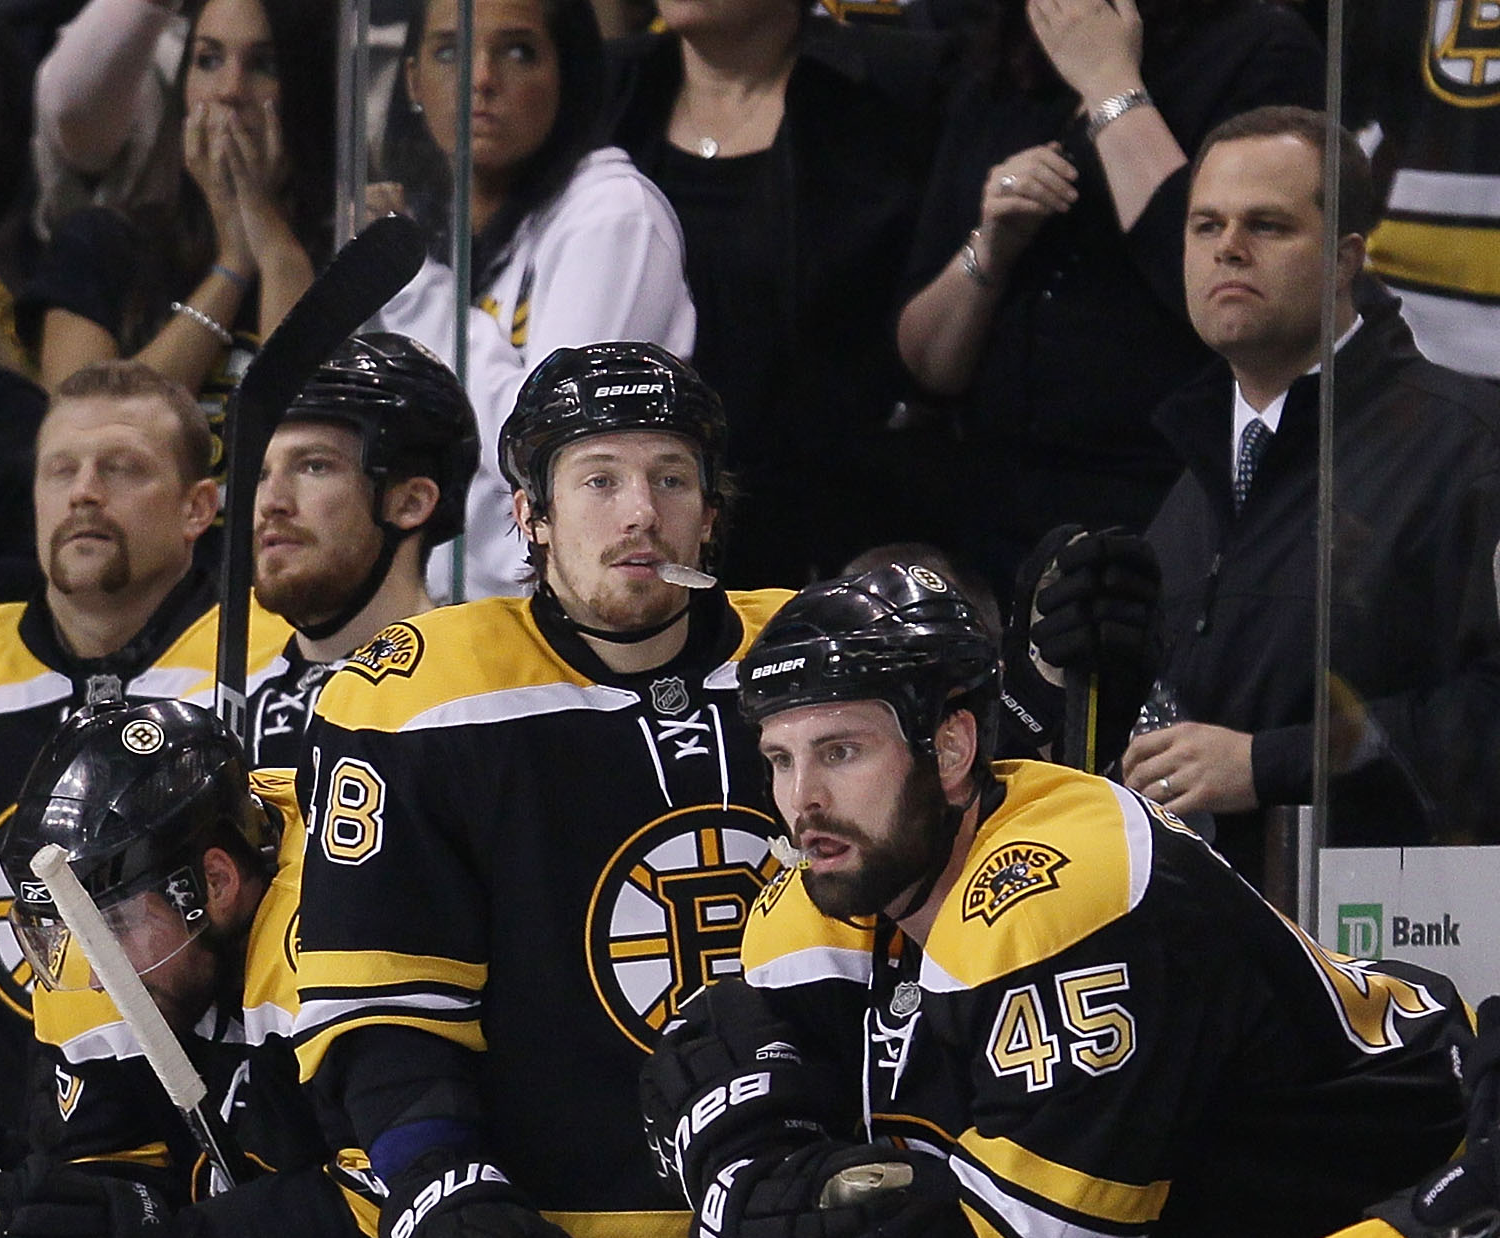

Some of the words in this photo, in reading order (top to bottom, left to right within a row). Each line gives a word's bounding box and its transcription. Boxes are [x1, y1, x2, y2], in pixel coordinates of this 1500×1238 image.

[594, 384, 664, 398] BAUER
[751, 657, 806, 680] BAUER
[305, 745, 386, 866] 8
[969, 848, 1052, 910] BRUINS
[1341, 916, 1380, 960] TD
[1392, 912, 1460, 947] Bank
[985, 962, 1137, 1093] 45
